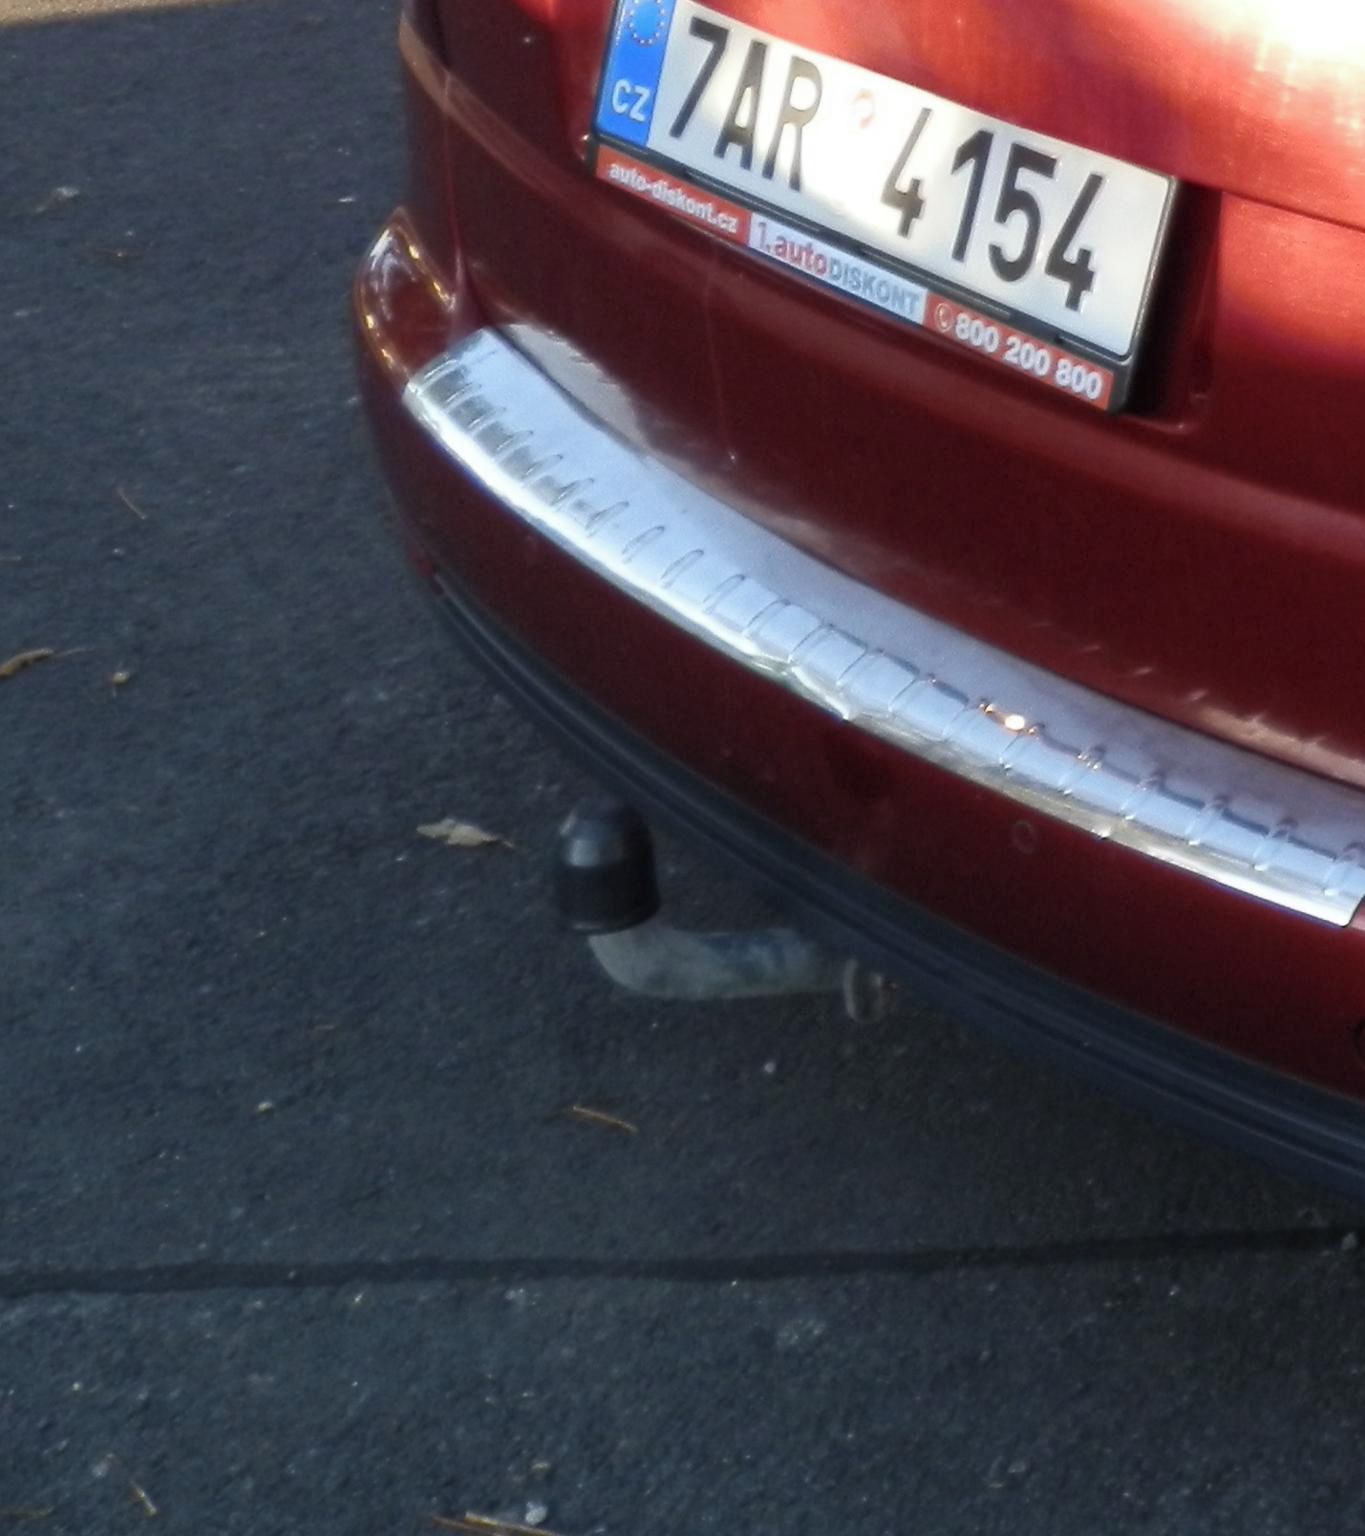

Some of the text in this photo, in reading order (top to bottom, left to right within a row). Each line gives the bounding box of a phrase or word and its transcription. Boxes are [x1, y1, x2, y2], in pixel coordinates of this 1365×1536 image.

[611, 79, 651, 122] CZ
[608, 162, 740, 235] auto-diskont.cz
[668, 15, 1104, 313] 7AR 4154
[955, 312, 1103, 400] 800 200 800
